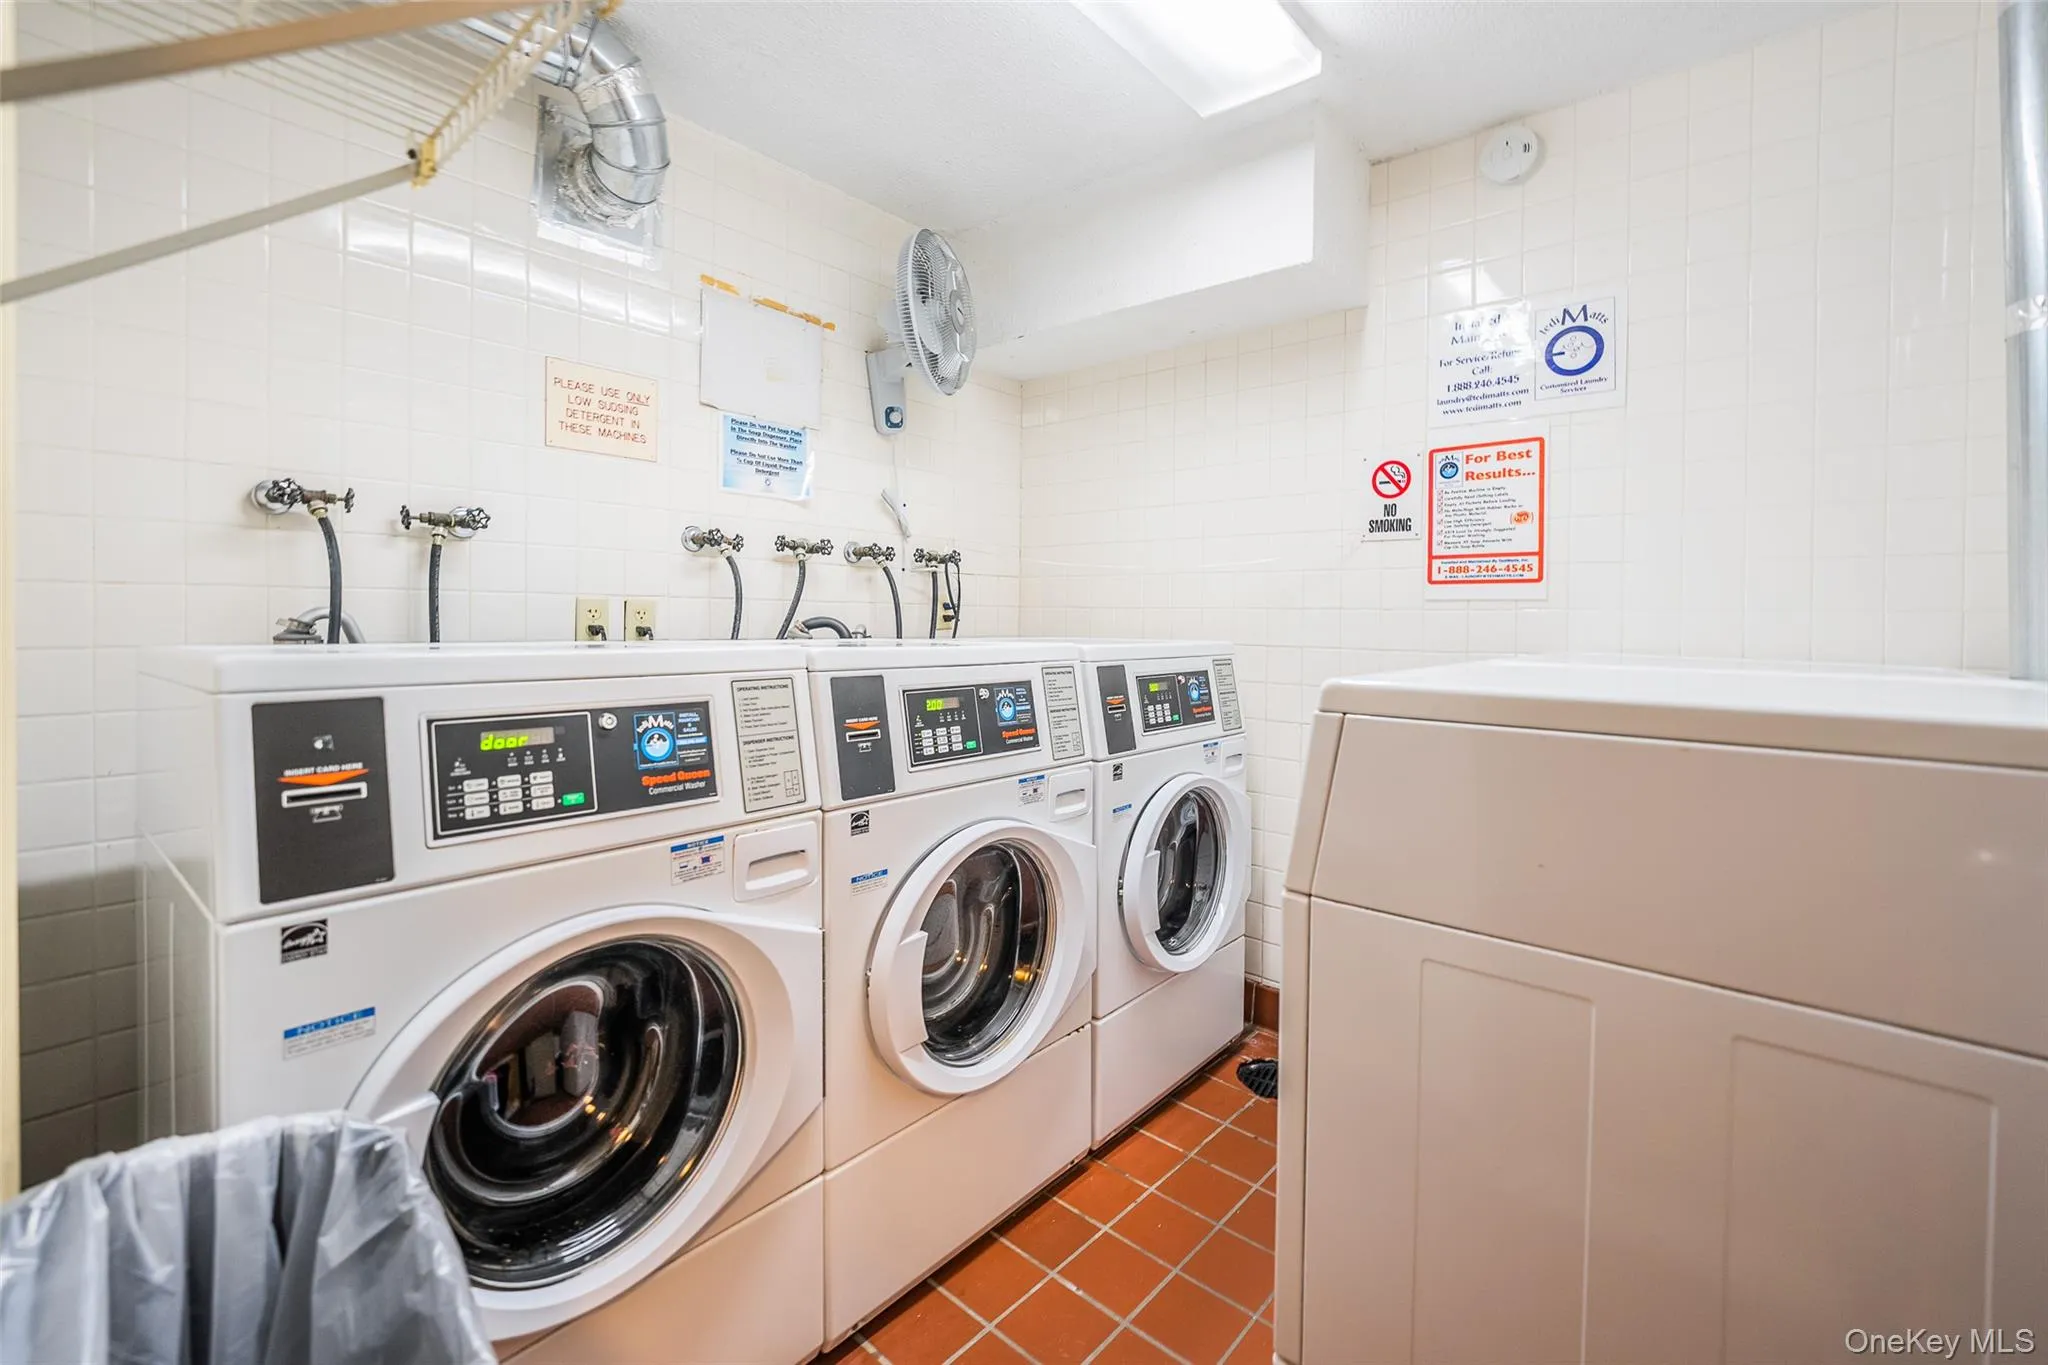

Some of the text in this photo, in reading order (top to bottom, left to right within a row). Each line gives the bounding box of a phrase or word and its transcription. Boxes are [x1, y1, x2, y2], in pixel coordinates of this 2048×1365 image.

[1439, 360, 1453, 368] For
[554, 377, 650, 404] PLEASE USE ONLY
[567, 395, 639, 416] LOW SUDSING
[566, 408, 640, 429] DETERGENT IN
[731, 418, 748, 426] Please
[559, 420, 647, 444] THESE MACHINES
[1465, 454, 1491, 464] For
[1496, 449, 1533, 462] Best
[1465, 468, 1536, 481] Results...
[1384, 503, 1397, 517] NO
[1369, 518, 1412, 533] SMOKING
[1437, 563, 1533, 574] 1-888-246-4545
[480, 734, 529, 751] door
[316, 764, 340, 773] CARD
[341, 762, 363, 770] HERE
[642, 769, 712, 787] Speed Queen
[648, 781, 706, 795] Commercial Washer
